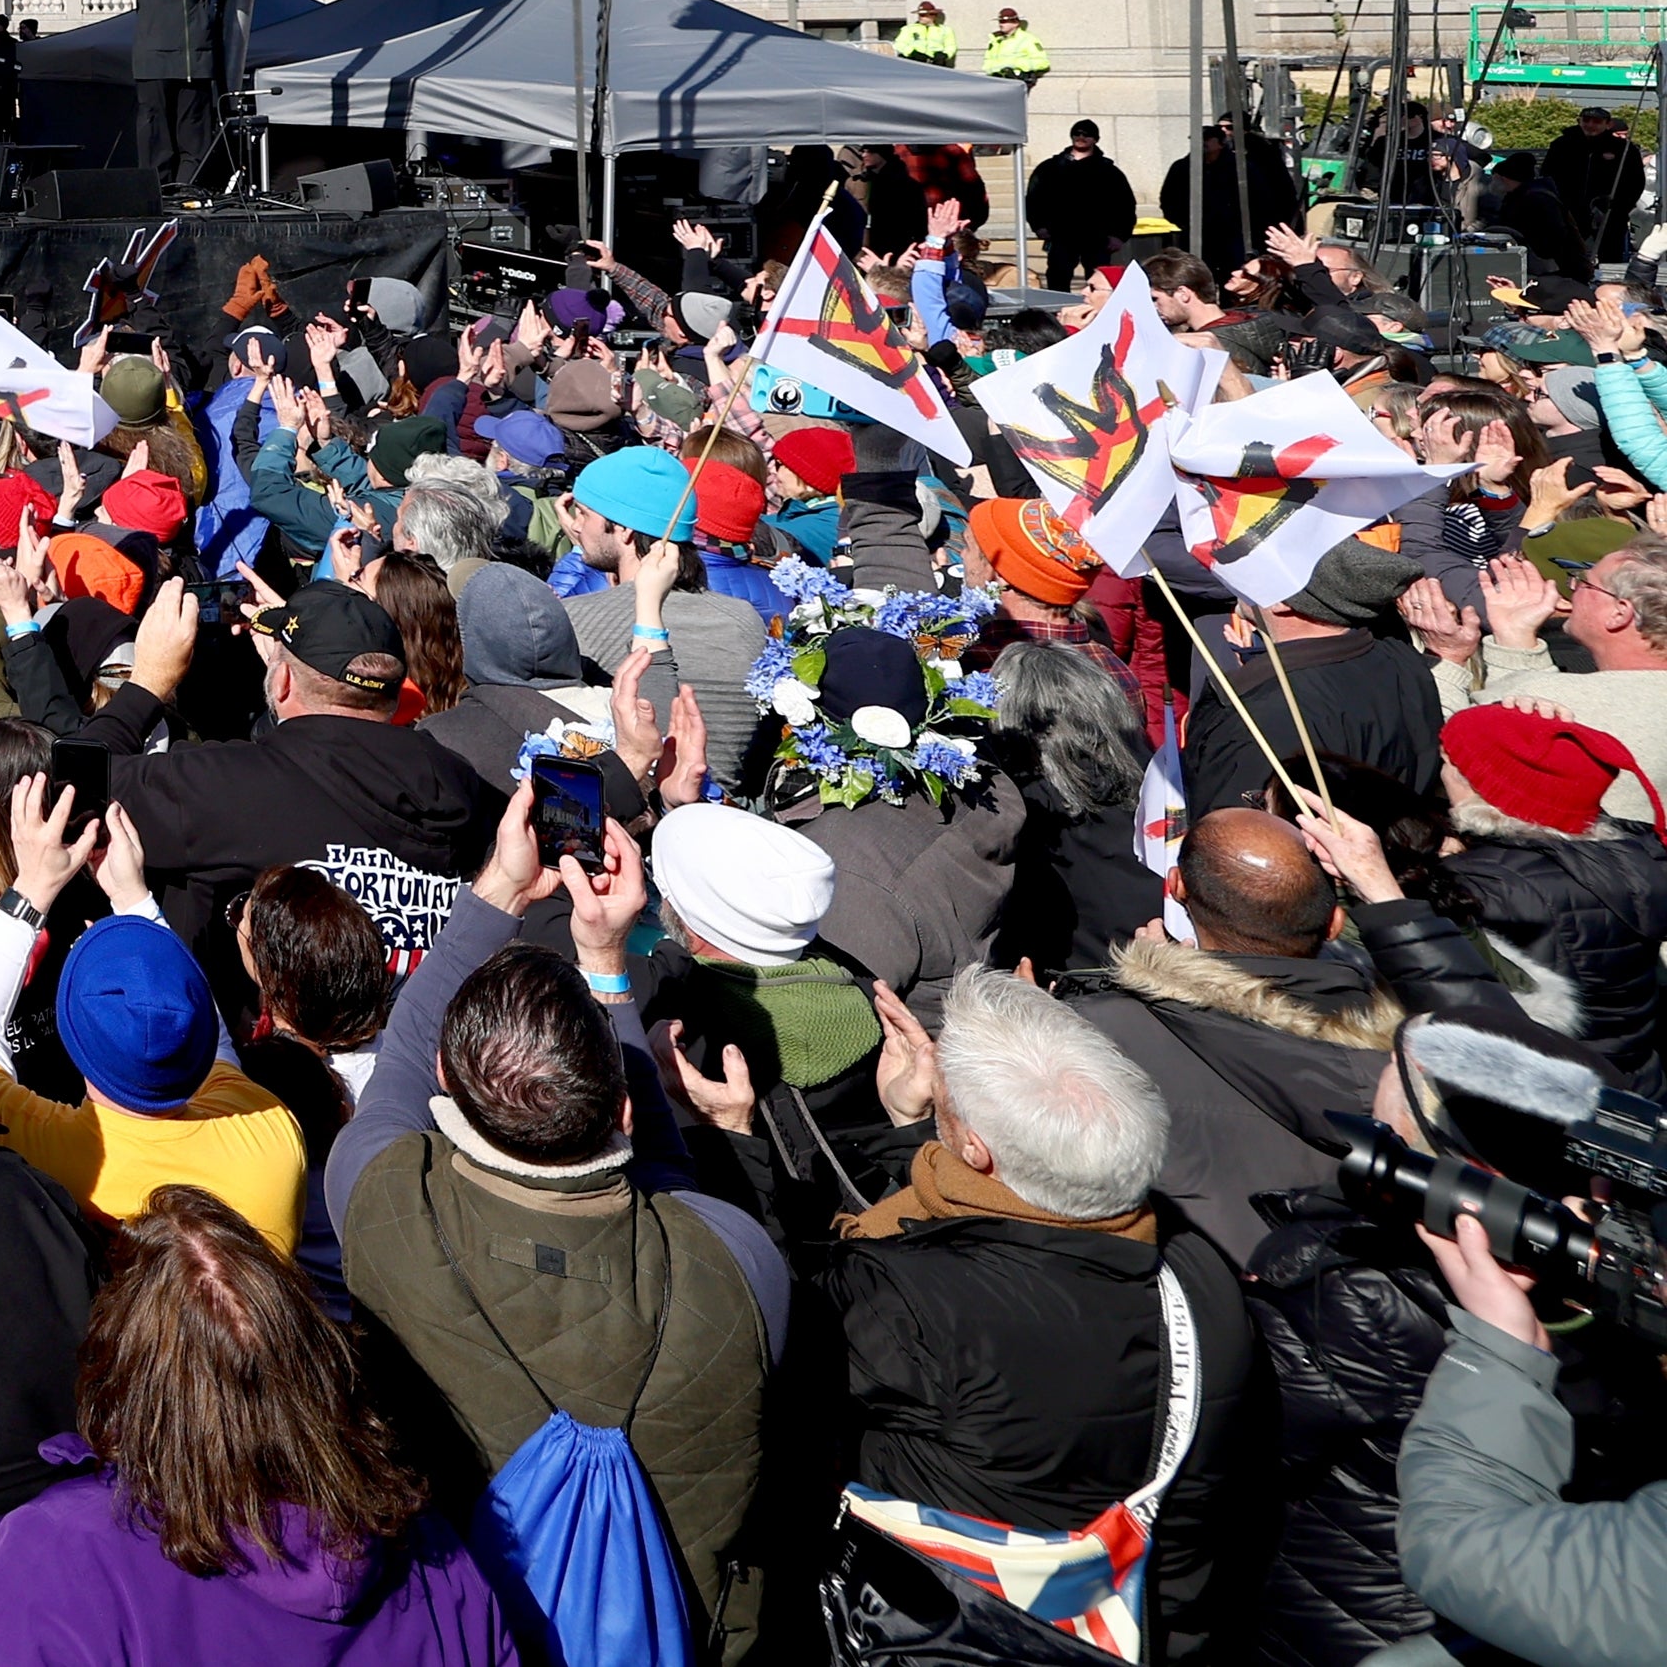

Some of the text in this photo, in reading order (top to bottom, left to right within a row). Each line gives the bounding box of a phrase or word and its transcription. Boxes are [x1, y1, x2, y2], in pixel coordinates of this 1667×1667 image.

[346, 674, 385, 689] U.S. ARMY
[329, 848, 343, 863] I
[334, 871, 460, 910] FORTUNAT
